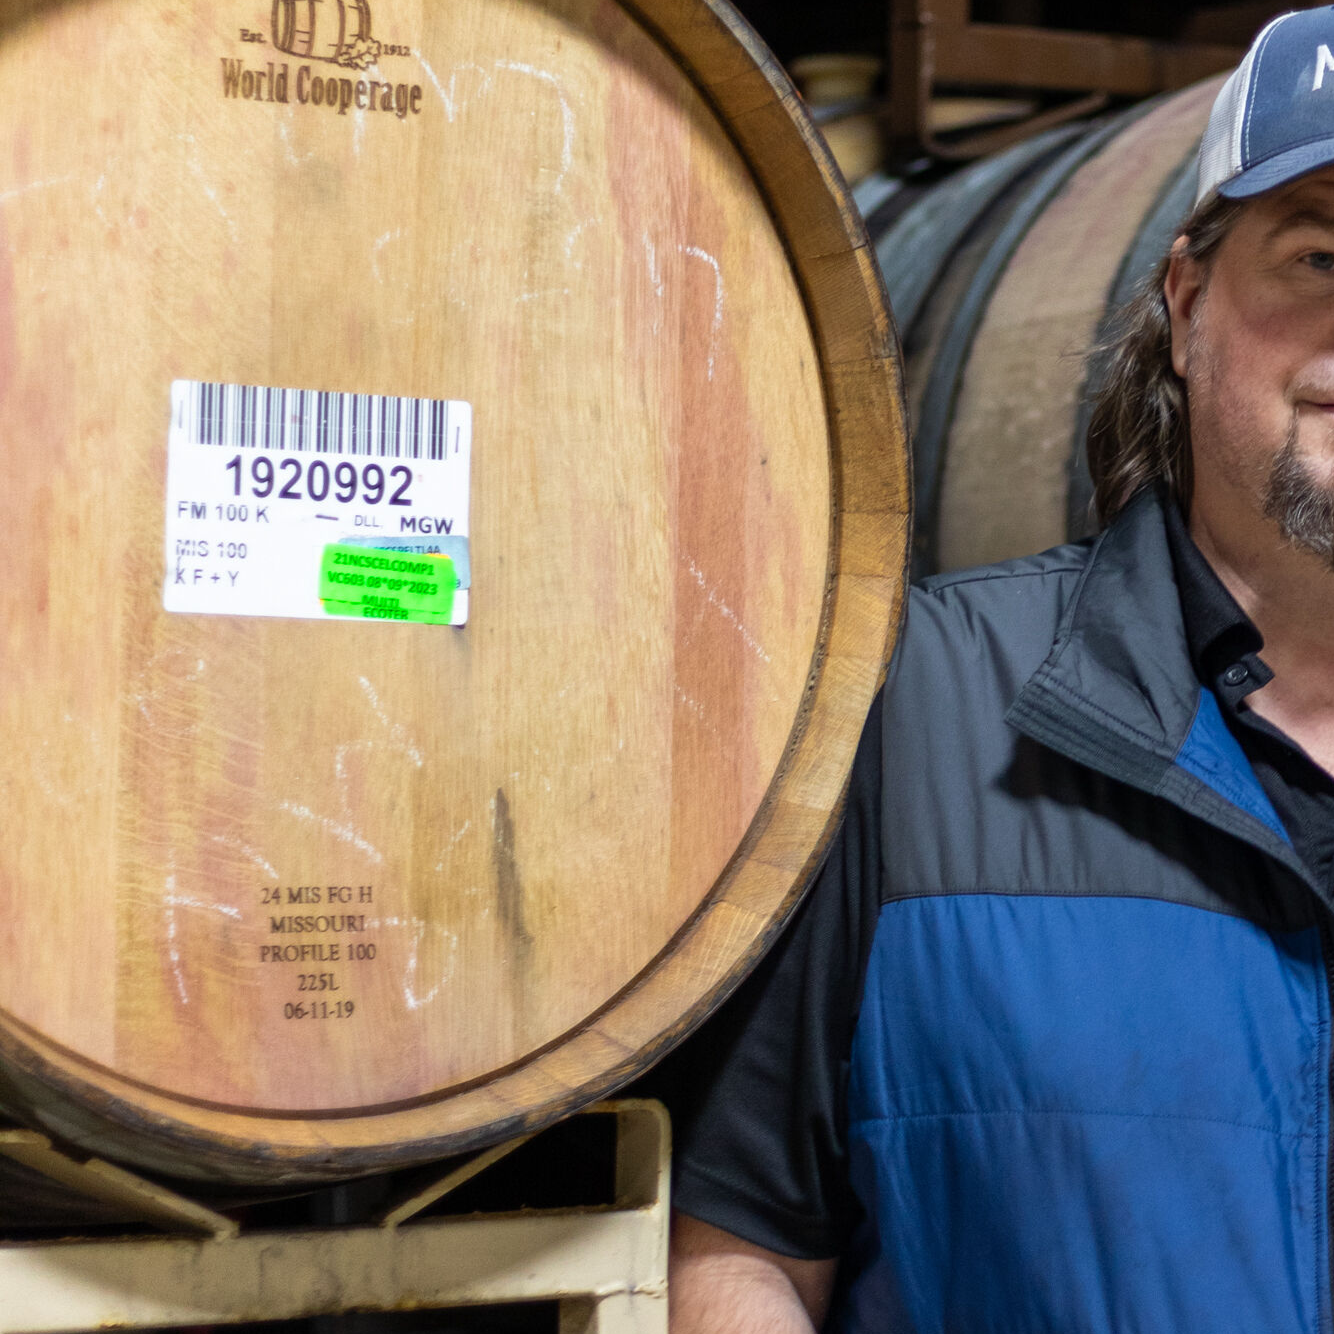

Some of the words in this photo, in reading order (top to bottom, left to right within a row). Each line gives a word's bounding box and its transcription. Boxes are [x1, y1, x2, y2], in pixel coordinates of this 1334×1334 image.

[239, 28, 268, 44] Est.
[383, 44, 412, 57] 1912
[220, 57, 290, 104] World
[296, 65, 423, 119] Cooperage
[225, 454, 414, 507] 1920992
[177, 501, 207, 520] FM
[215, 503, 249, 523] 100
[256, 505, 270, 524] K
[400, 515, 454, 535] MGW
[217, 541, 248, 560] 100
[193, 569, 204, 585] F
[228, 570, 240, 587] Y
[260, 886, 282, 905] 24
[287, 886, 322, 904] MIS
[327, 885, 353, 904] FG
[358, 885, 374, 904] H
[269, 915, 366, 934] MISSOURI
[260, 944, 341, 963] PROFILE
[347, 943, 377, 961] 100
[297, 973, 341, 992] 225L
[283, 1000, 356, 1020] 06-11-19
